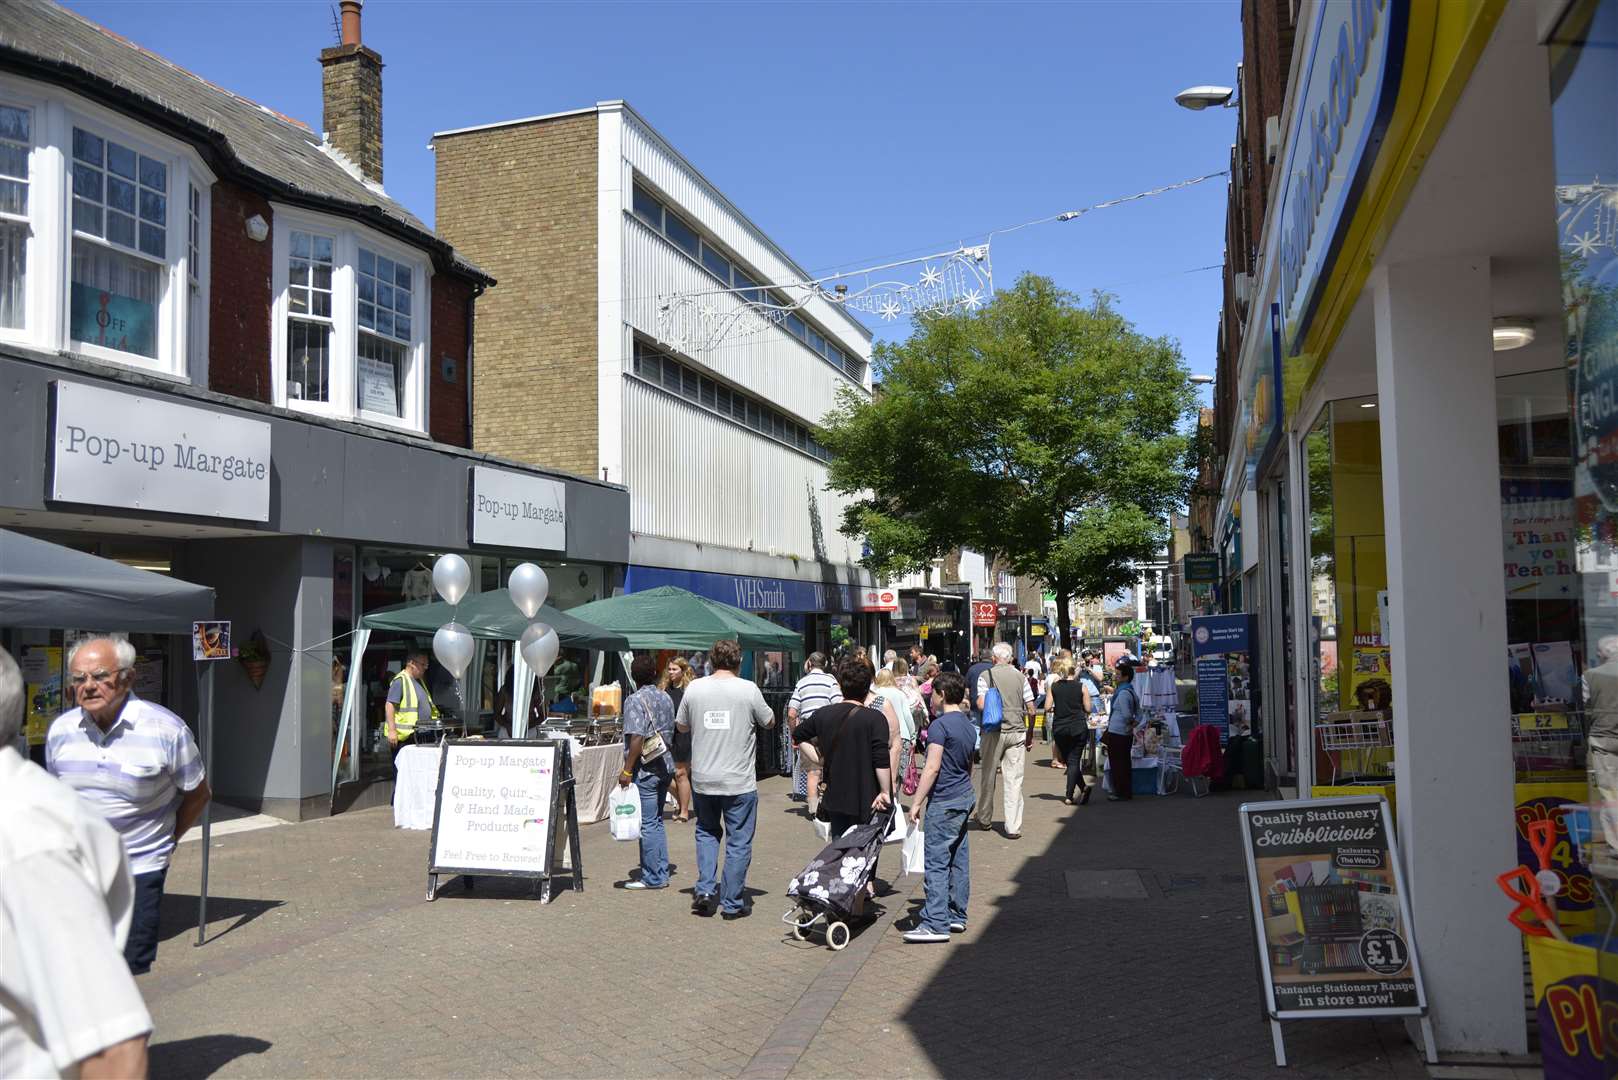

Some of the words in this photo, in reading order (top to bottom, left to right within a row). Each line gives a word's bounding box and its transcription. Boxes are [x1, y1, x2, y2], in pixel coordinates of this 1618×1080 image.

[65, 425, 165, 470] Pop-up
[173, 443, 266, 481] Margate
[477, 494, 519, 520] Pop-up
[522, 502, 564, 525] Margate
[1528, 548, 1569, 563] you
[734, 578, 786, 609] WHSmith
[1536, 714, 1552, 727] £2
[455, 754, 495, 768] Pop-up
[499, 755, 546, 768] Margate
[451, 785, 496, 799] Quality,
[454, 803, 465, 815] &
[467, 803, 500, 815] Hand
[503, 804, 535, 816] Made
[1252, 813, 1304, 828] Quality
[1306, 808, 1379, 823] Stationery
[467, 820, 519, 833] Products
[1256, 825, 1377, 847] Scribblicious
[465, 850, 487, 861] Free
[489, 851, 500, 861] to
[1341, 856, 1354, 864] The
[1551, 840, 1574, 868] 4
[1366, 940, 1403, 965] £1
[1275, 984, 1321, 995] Fantastic
[1323, 982, 1379, 994] Stationery
[1379, 982, 1416, 993] Range
[1298, 994, 1314, 1007] in
[1317, 995, 1355, 1006] store
[1358, 992, 1395, 1005] now!
